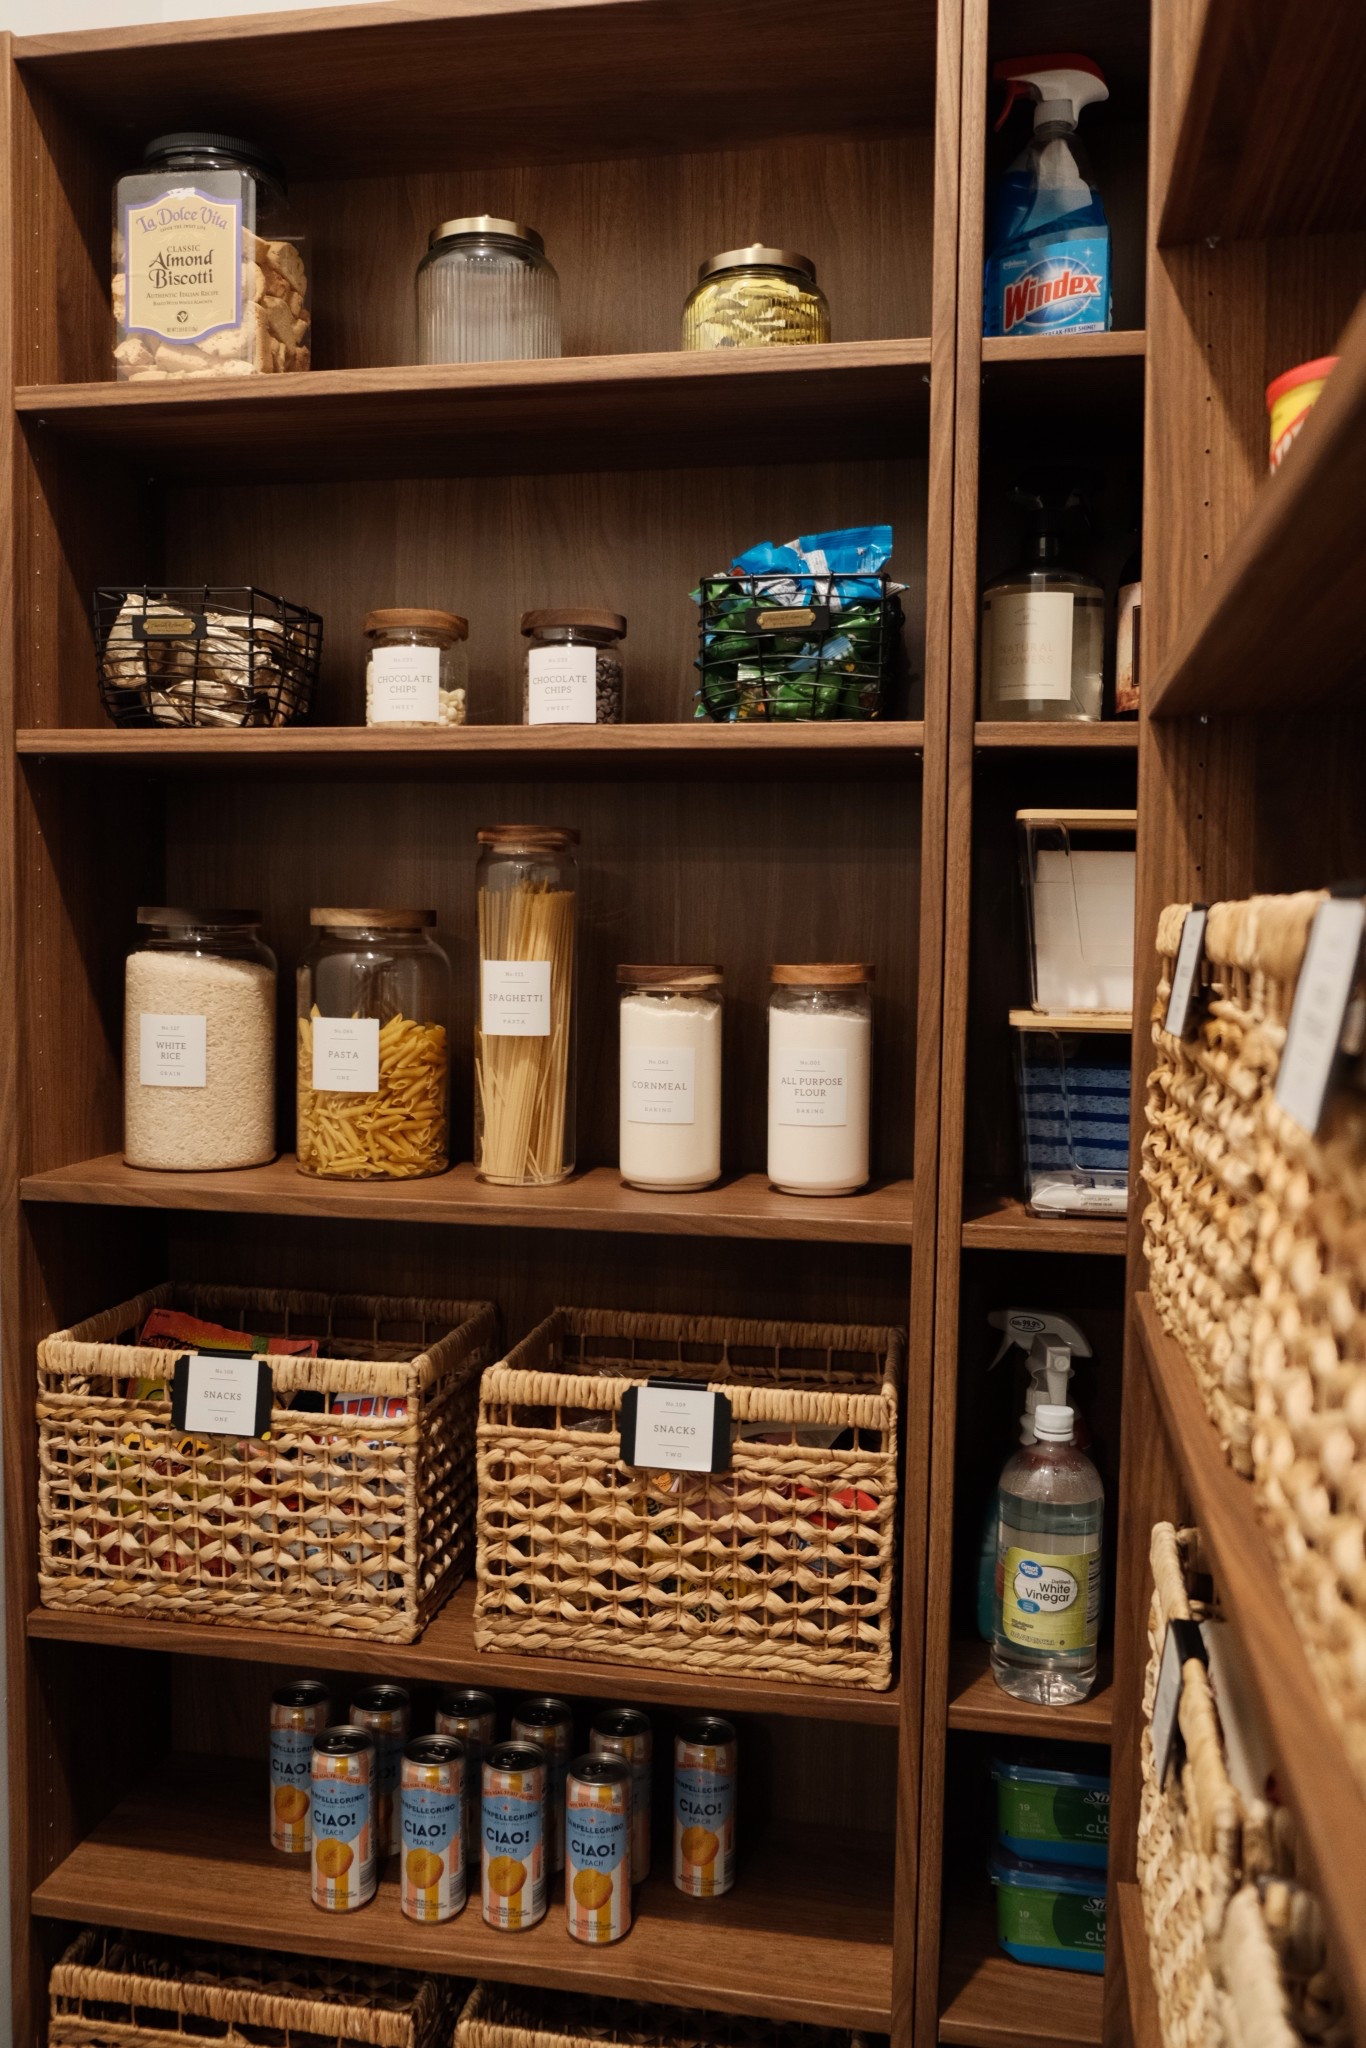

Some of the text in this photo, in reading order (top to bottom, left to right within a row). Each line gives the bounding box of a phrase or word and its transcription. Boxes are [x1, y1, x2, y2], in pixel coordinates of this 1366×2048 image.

[136, 206, 228, 234] La Dolce Vita
[167, 244, 200, 253] CLASSIC
[148, 249, 214, 270] Almond
[148, 268, 214, 288] Biscotti
[1004, 270, 1100, 332] Windex
[377, 674, 432, 684] CHOCOLATE
[532, 675, 588, 685] CHOCOLATE
[390, 685, 417, 693] CHIPS
[545, 686, 572, 694] CHIPS
[489, 994, 543, 1002] SPAGHETTI
[156, 1041, 187, 1050] WHITE
[160, 1052, 181, 1060] RICE
[328, 1050, 359, 1059] PASTA
[632, 1081, 688, 1091] CORNMEAL
[781, 1077, 843, 1086] ALL PURPOSE
[794, 1089, 827, 1097] FLOUR
[203, 1391, 242, 1401] SNACKS
[654, 1425, 696, 1435] SNACKS
[1040, 1583, 1071, 1594] White
[1025, 1588, 1070, 1604] Vinegar
[272, 1759, 311, 1774] CIAO!
[680, 1798, 722, 1816] CIAO!
[1019, 1803, 1030, 1811] 19
[314, 1809, 356, 1826] CIAO!
[689, 1816, 710, 1824] PEACH
[322, 1828, 344, 1836] PEACH
[404, 1820, 446, 1837] CIAO!
[486, 1827, 529, 1844] CIAO!
[413, 1838, 434, 1846] PEACH
[496, 1846, 518, 1854] PEACH
[572, 1840, 615, 1857] CIAO!
[581, 1858, 604, 1866] PEACH
